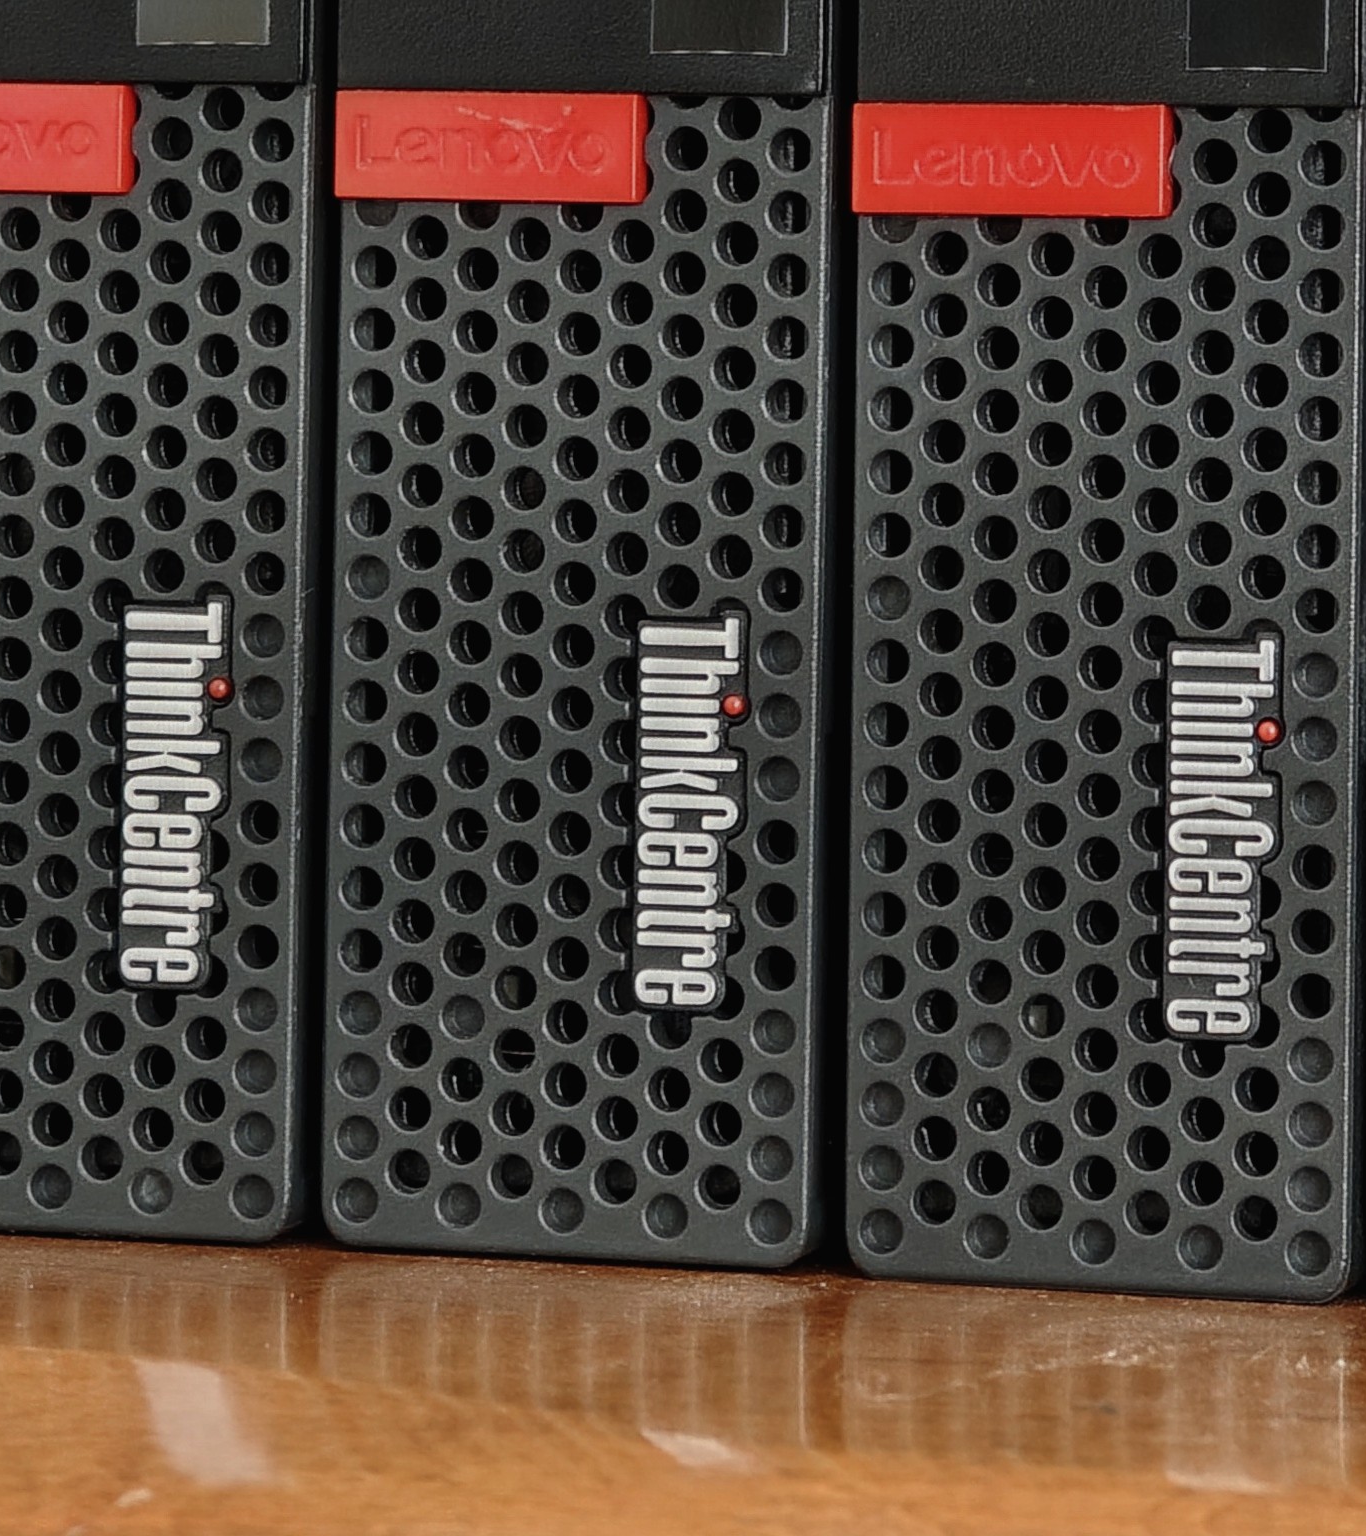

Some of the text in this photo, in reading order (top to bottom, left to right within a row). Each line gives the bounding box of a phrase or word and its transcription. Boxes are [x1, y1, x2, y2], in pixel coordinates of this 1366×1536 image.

[356, 115, 612, 172] Lenovo
[873, 128, 1141, 189] Lenovo
[120, 601, 233, 983] ThinkCentre
[635, 618, 747, 1006] ThinkCentre
[1166, 640, 1281, 1035] ThinkCentre
